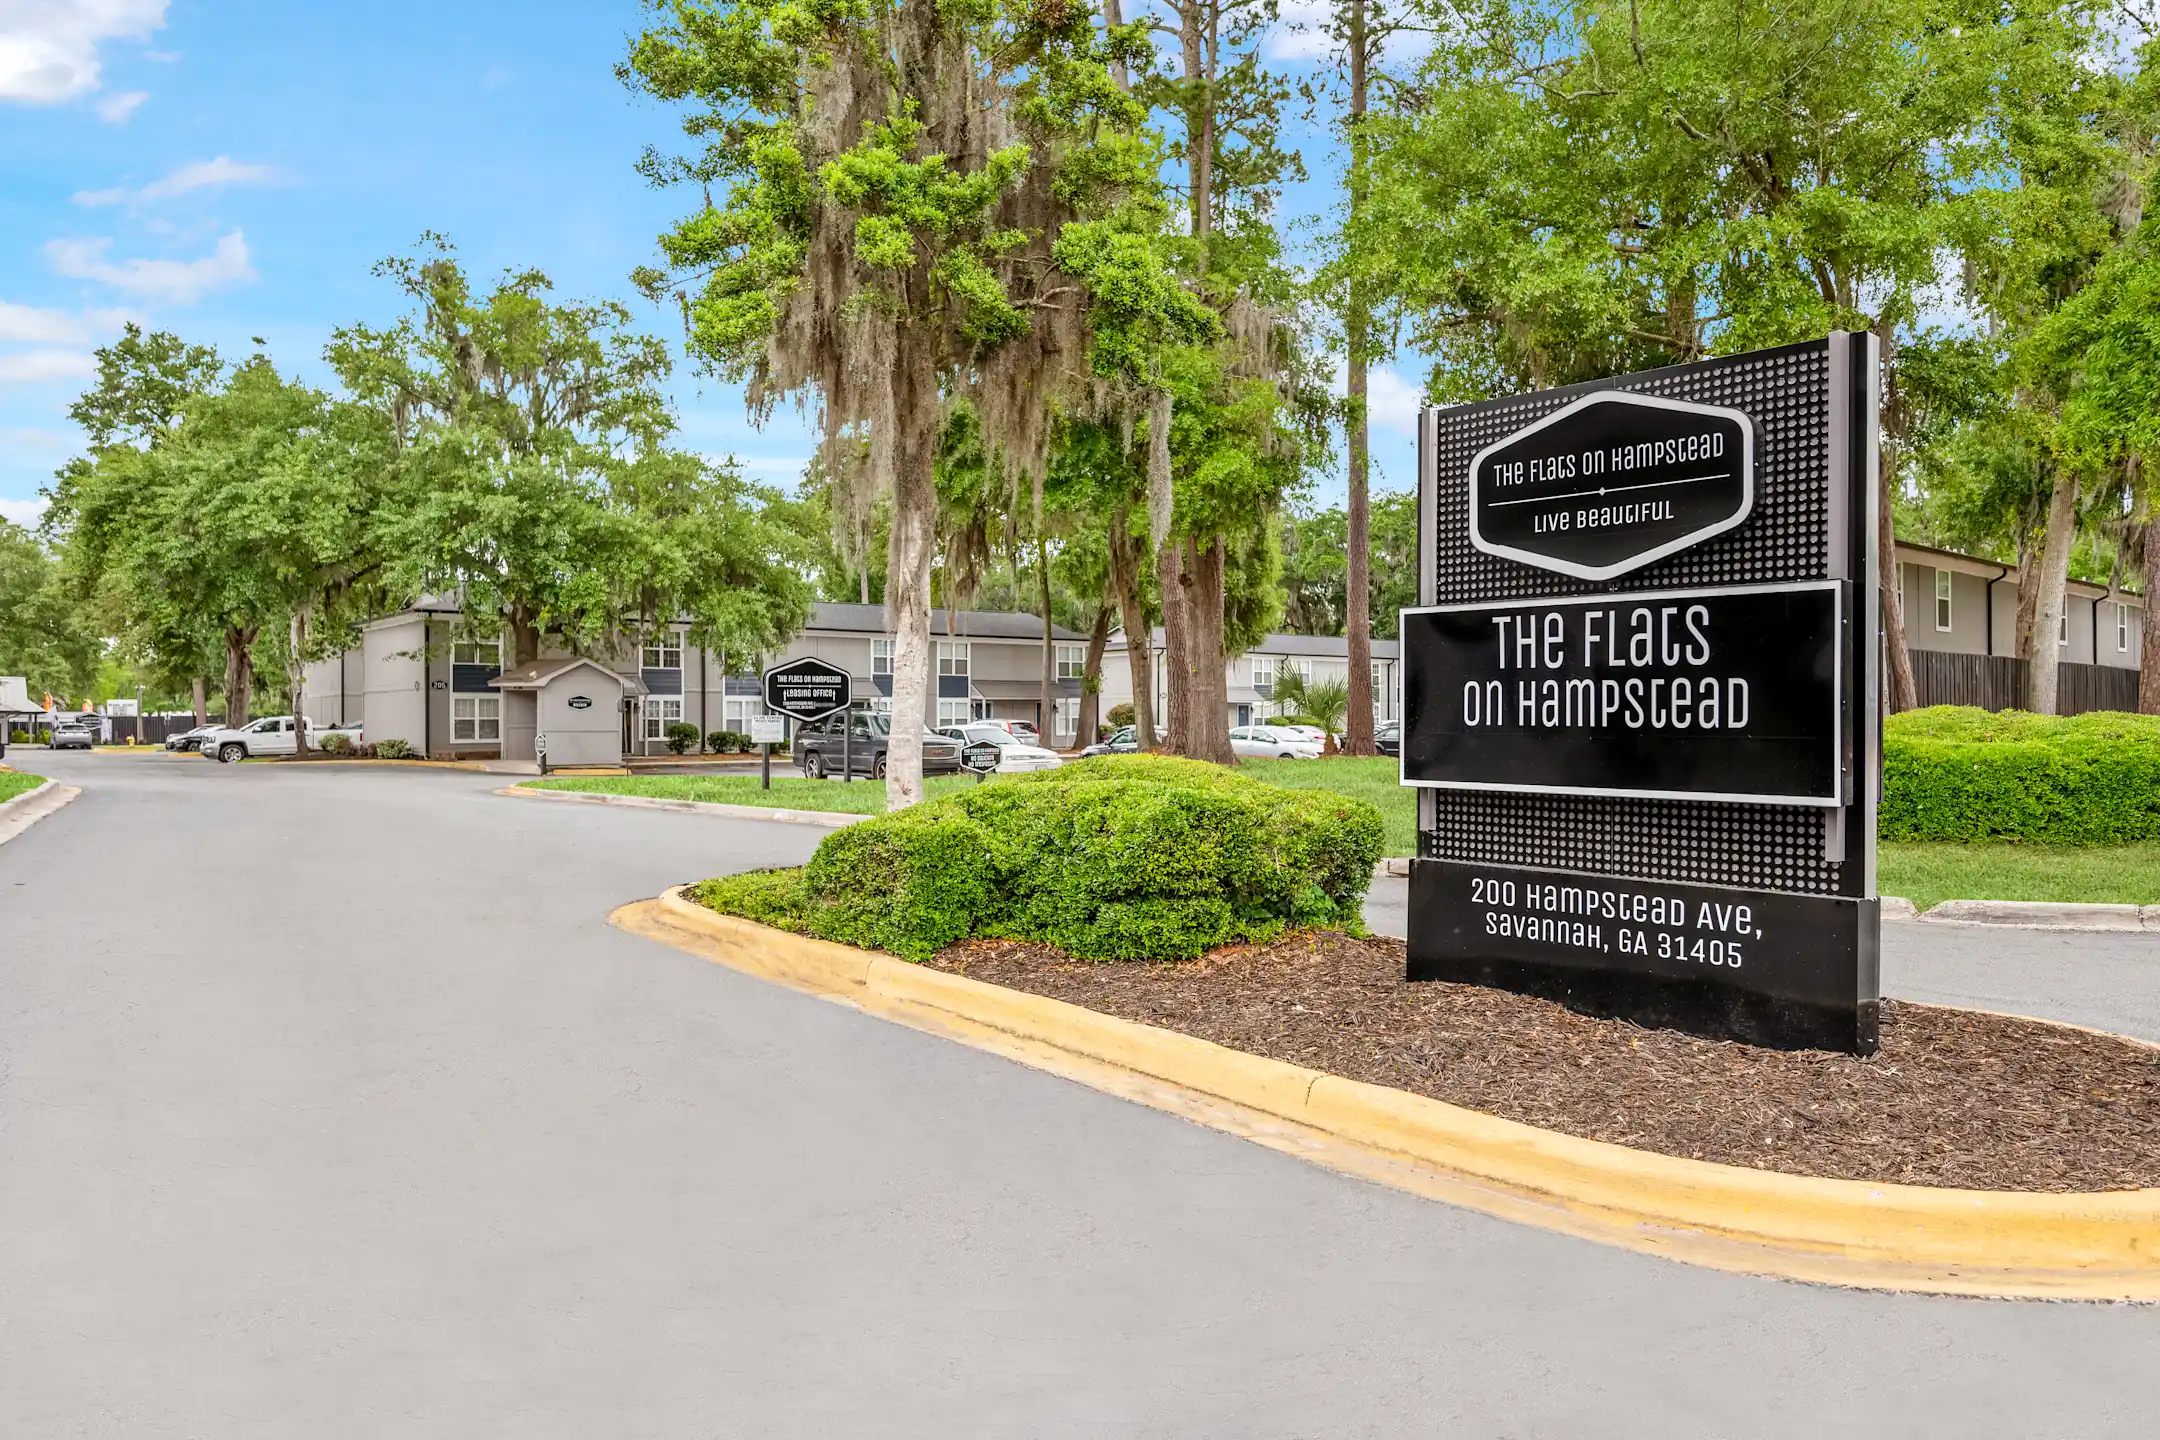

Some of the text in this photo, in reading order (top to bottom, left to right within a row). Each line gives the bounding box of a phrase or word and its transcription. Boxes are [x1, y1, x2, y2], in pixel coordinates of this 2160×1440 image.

[1470, 877, 1516, 907] 200
[1618, 928, 1649, 956] GA
[1657, 932, 1743, 969] 31405
